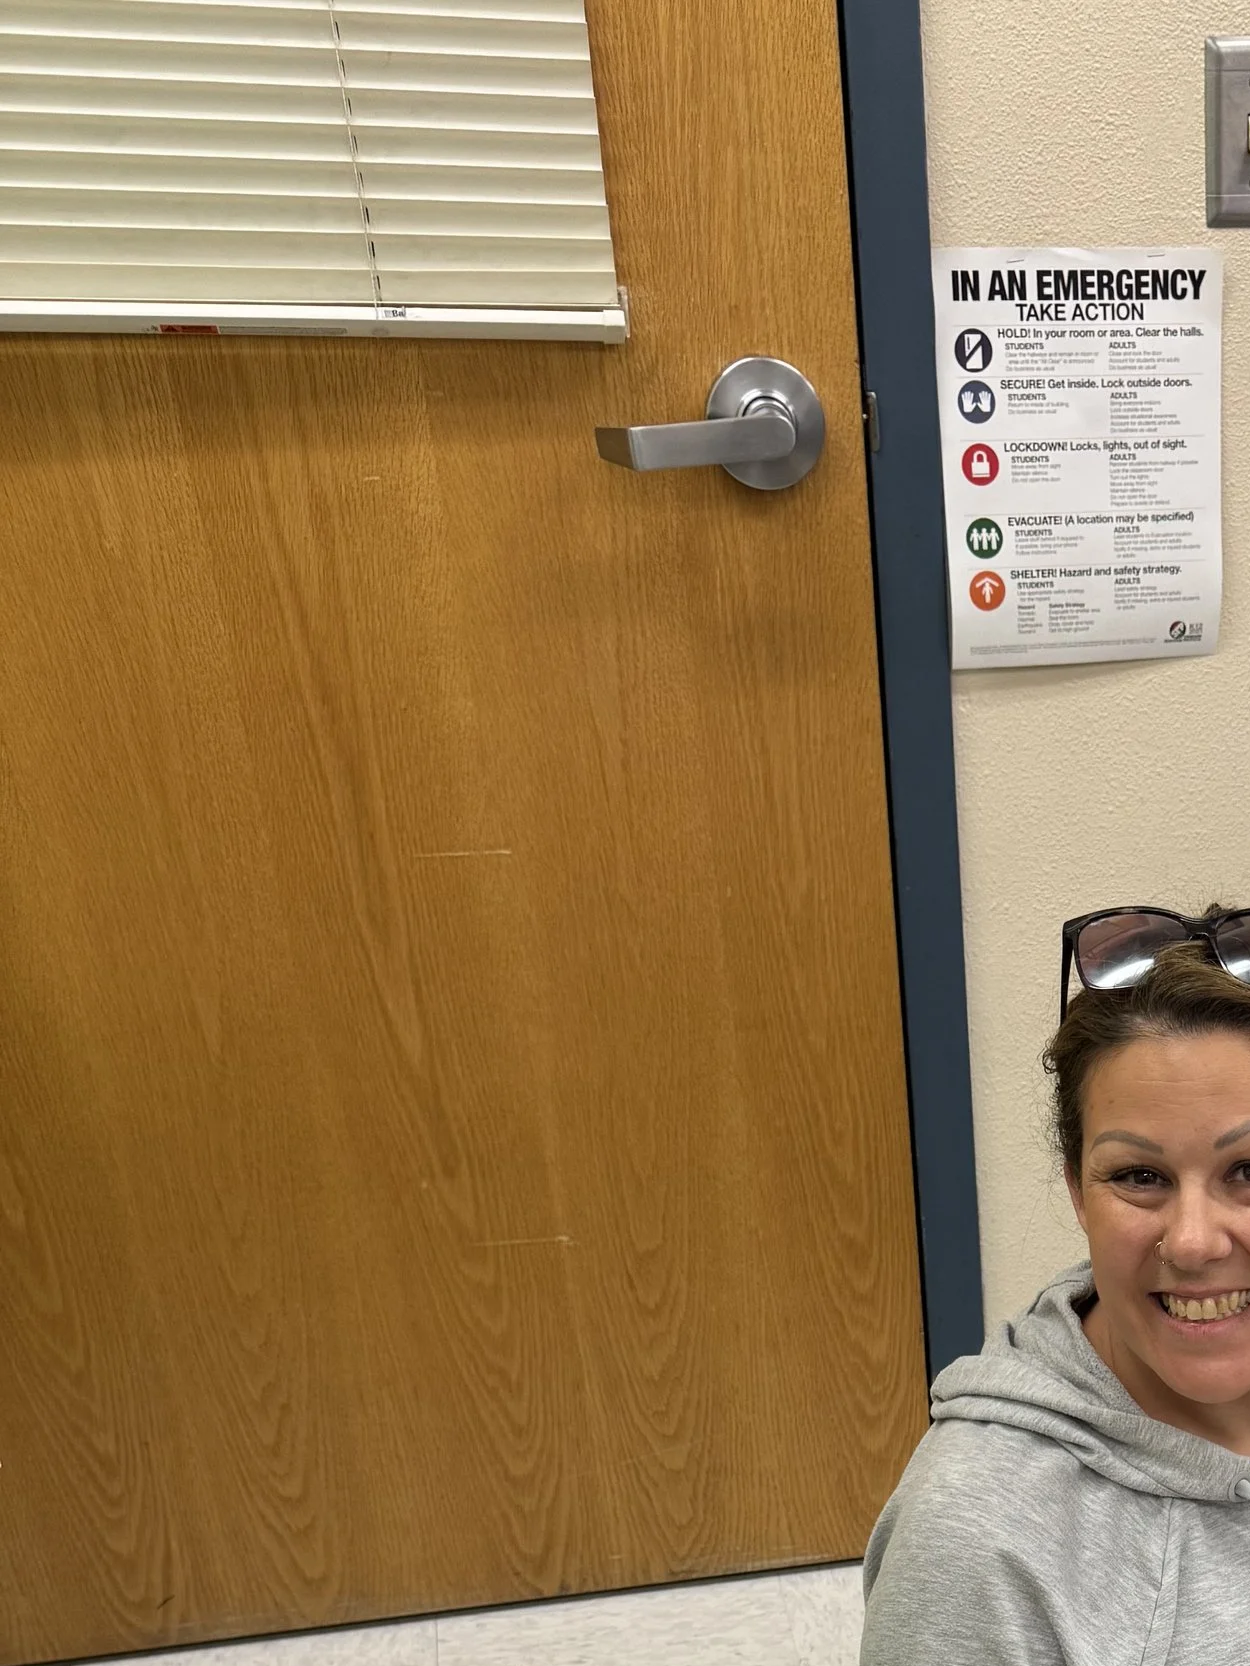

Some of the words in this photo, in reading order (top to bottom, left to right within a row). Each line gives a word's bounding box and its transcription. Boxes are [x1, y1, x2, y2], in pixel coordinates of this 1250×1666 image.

[951, 269, 979, 301] IN
[988, 269, 1027, 301] AN
[1036, 268, 1206, 301] EMERGENCY
[1015, 303, 1067, 321] TAKE
[1071, 302, 1144, 321] ACTION
[997, 328, 1031, 339] HOLD!
[1033, 328, 1043, 338] In
[1045, 330, 1067, 340] your
[1069, 330, 1095, 338] room
[1097, 330, 1108, 338] or
[1109, 329, 1133, 338] area.
[1135, 327, 1161, 337] Clear
[1163, 327, 1178, 337] the
[1180, 326, 1204, 337] halls.
[1005, 342, 1044, 350] STUDENTS
[1109, 341, 1136, 349] ADULTS
[1000, 379, 1046, 390] SECURE!
[1048, 379, 1065, 389] Get
[1067, 379, 1099, 389] inside.
[1101, 378, 1124, 388] Lock
[1126, 378, 1161, 388] outside
[1163, 377, 1192, 387] doors.
[1008, 393, 1046, 401] STUDENTS
[1110, 392, 1137, 400] ADULTS
[1003, 442, 1068, 453] LOCKDOWN!
[1070, 441, 1101, 452] Locks,
[1103, 440, 1131, 451] lights,
[1133, 441, 1148, 450] out
[1150, 439, 1160, 450] of
[1162, 439, 1187, 450] sight.
[1110, 453, 1136, 461] ADULTS
[1008, 516, 1063, 527] EVACUATE!
[1065, 515, 1075, 526] (A
[1076, 514, 1114, 525] location
[1115, 516, 1134, 525] may
[1137, 513, 1149, 523] be
[1151, 511, 1194, 523] specified)
[1015, 529, 1053, 537] STUDENTS
[1114, 526, 1140, 534] ADULTS
[1010, 568, 1057, 579] SHELTER!
[1059, 568, 1092, 578] Hazard
[1094, 567, 1112, 576] and
[1113, 565, 1141, 577] safety
[1142, 564, 1182, 575] strategy.
[1017, 581, 1054, 589] STUDENTS
[1114, 578, 1140, 586] ADULTS
